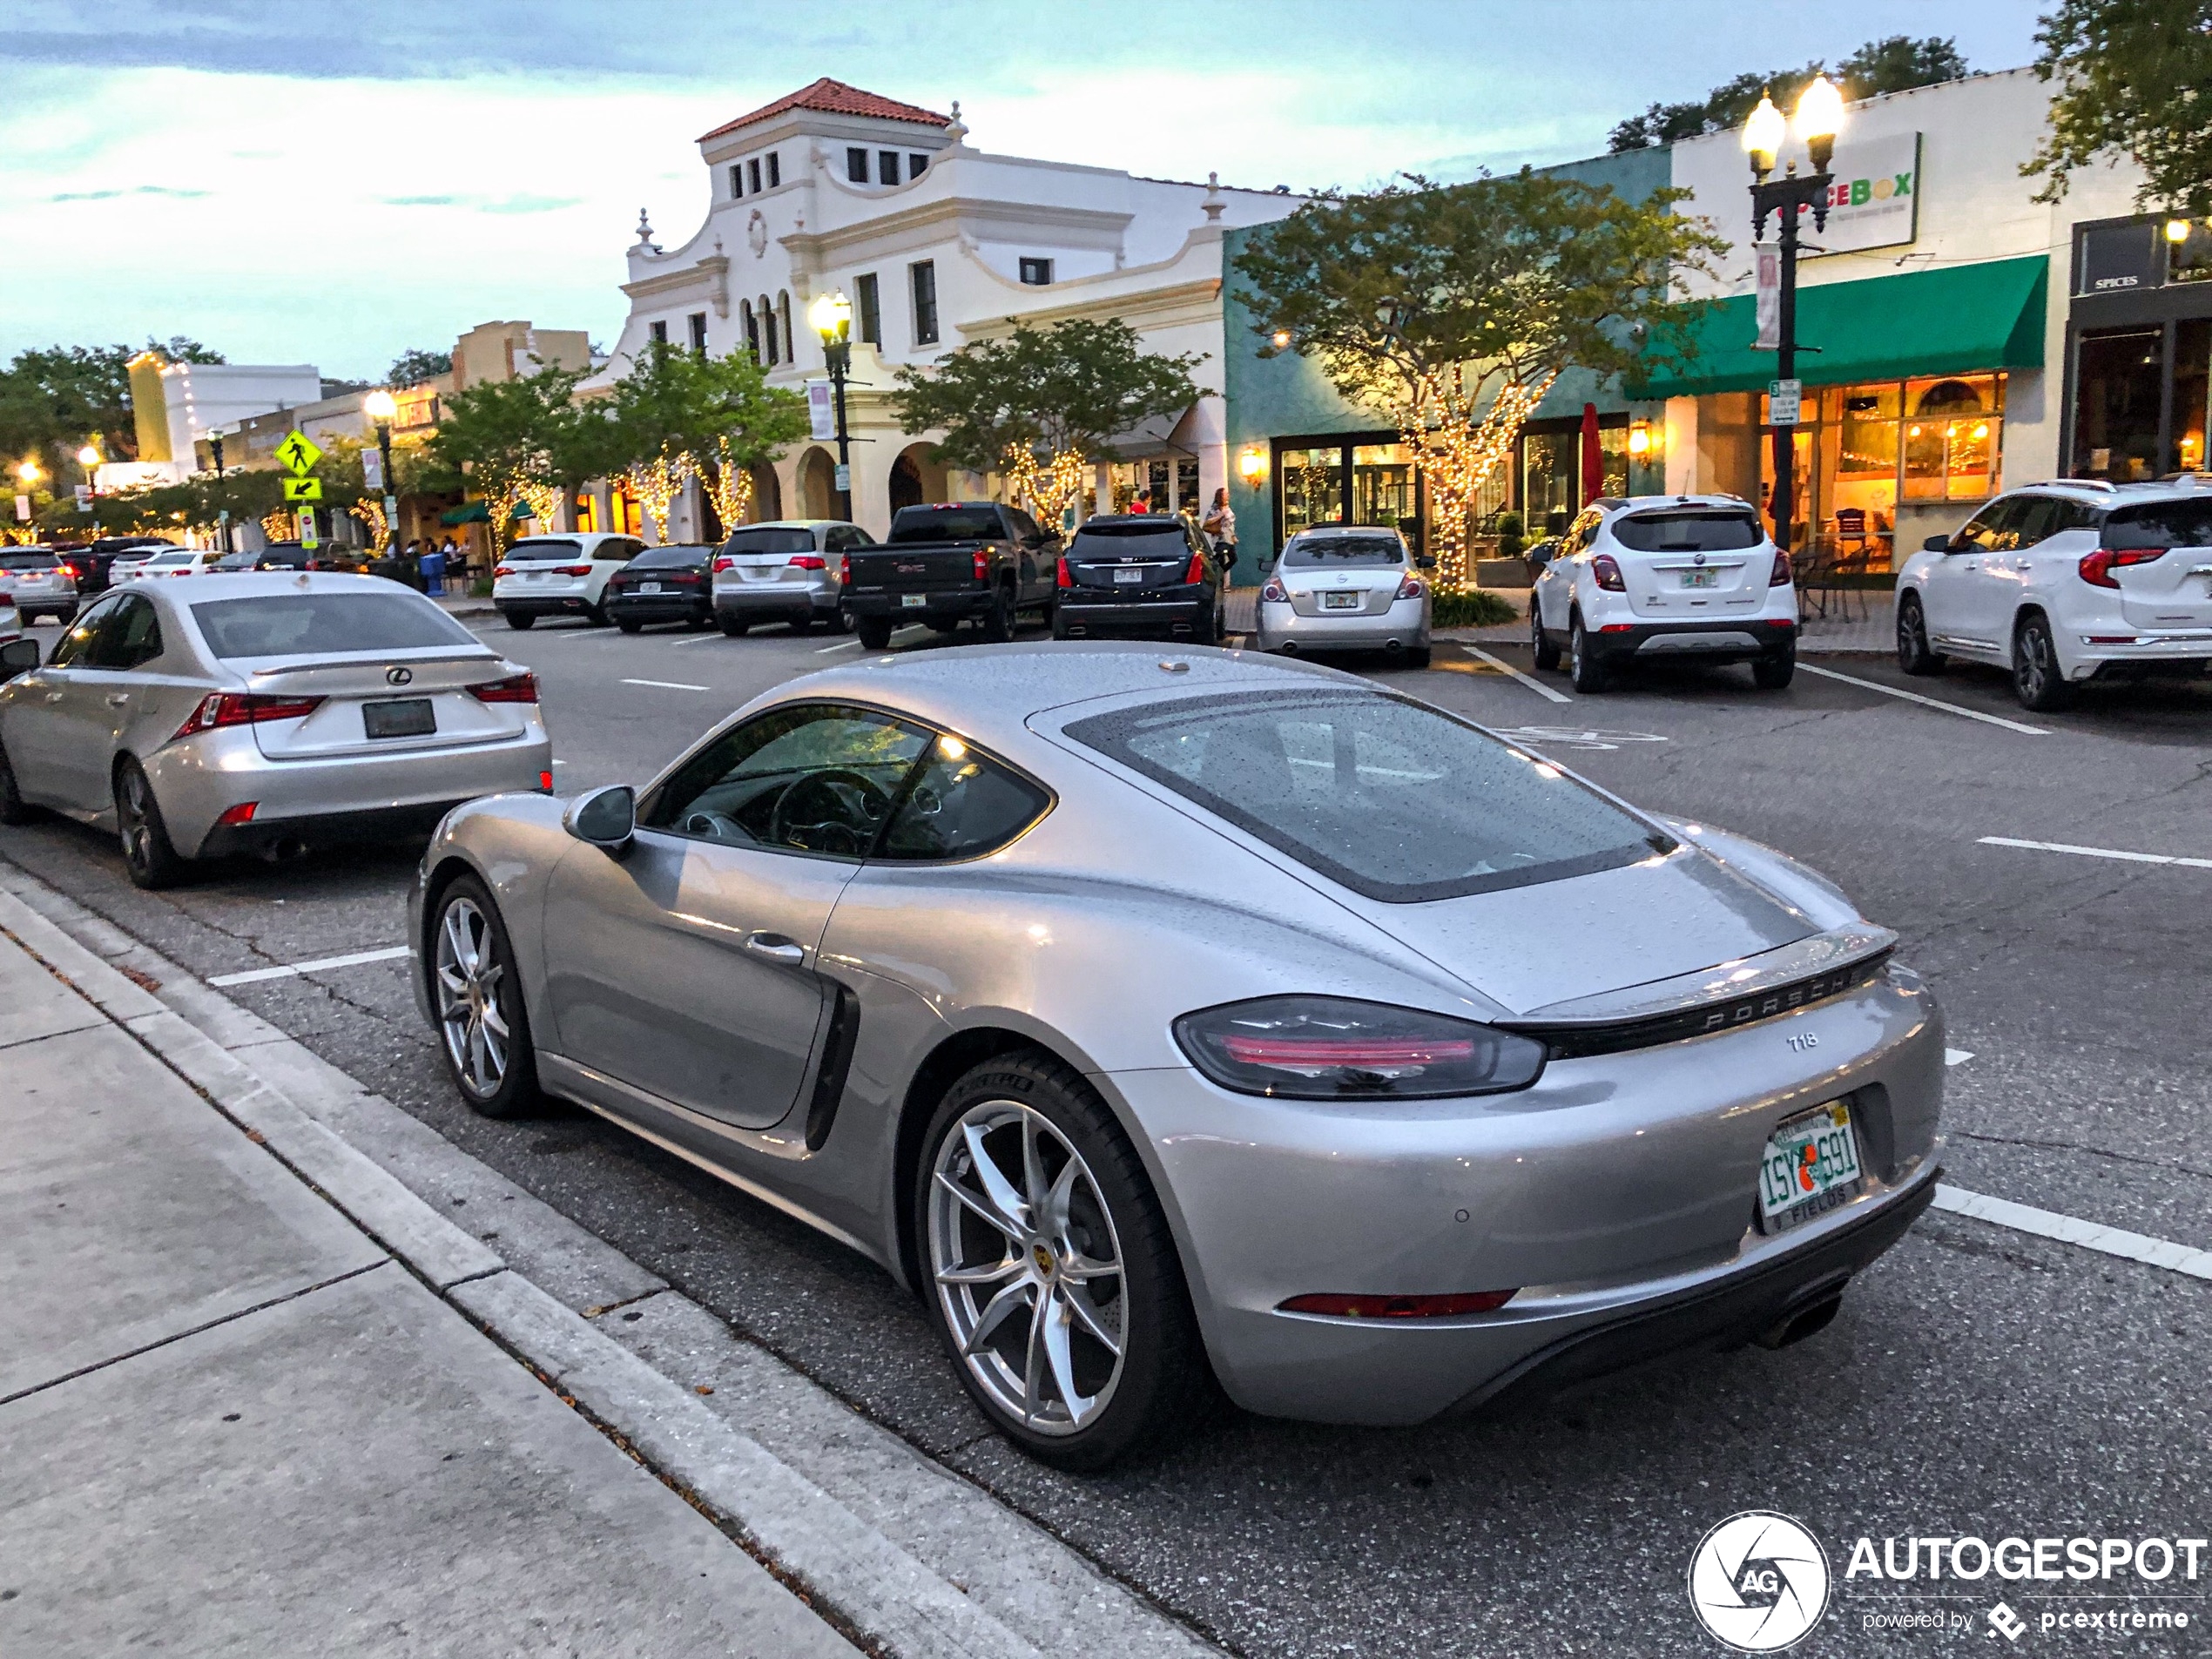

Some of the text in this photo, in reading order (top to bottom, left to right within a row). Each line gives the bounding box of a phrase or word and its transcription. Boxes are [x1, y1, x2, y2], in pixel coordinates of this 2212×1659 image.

[2094, 275, 2138, 288] SPICES
[1787, 1032, 1818, 1052] 718
[1791, 1187, 1847, 1222] FIELDS
